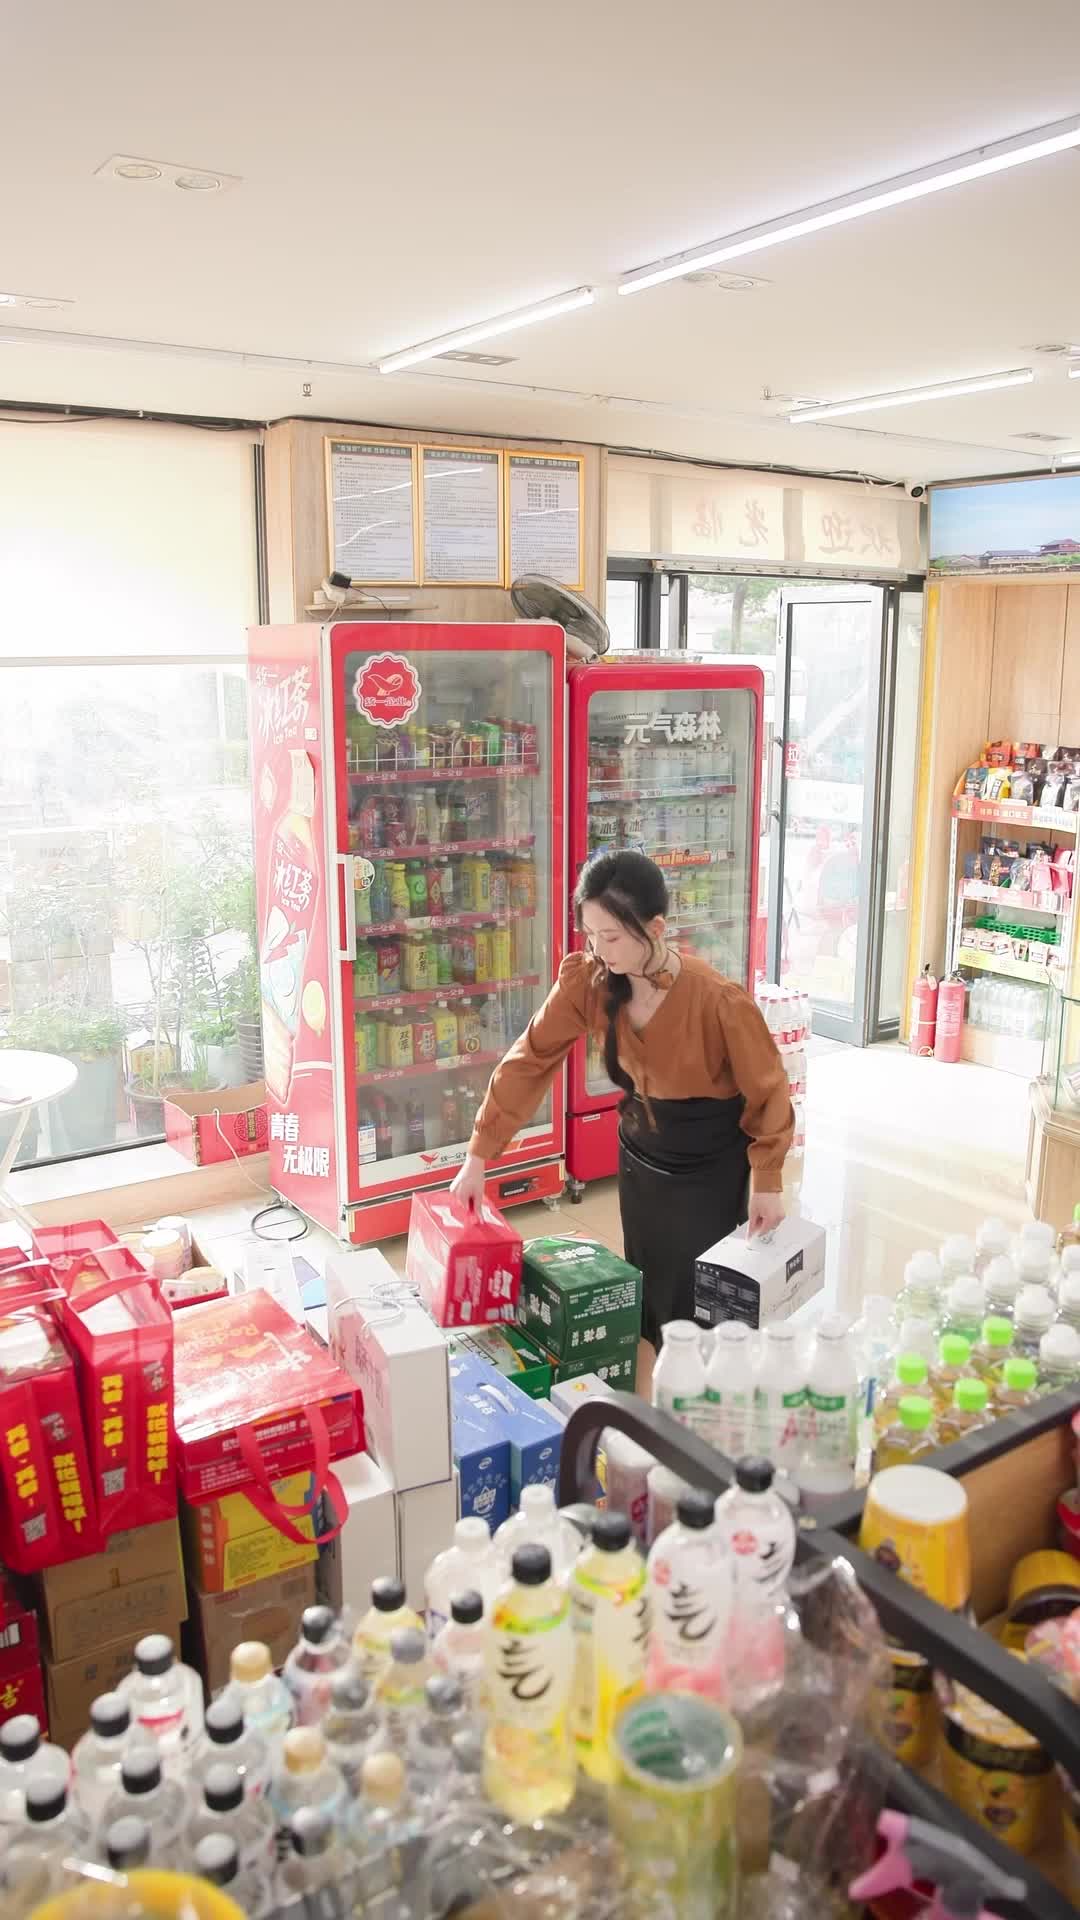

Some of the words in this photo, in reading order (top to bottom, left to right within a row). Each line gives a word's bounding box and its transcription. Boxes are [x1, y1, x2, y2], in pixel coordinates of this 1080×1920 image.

[623, 711, 722, 745] 元气森林
[270, 1112, 300, 1143] 青春
[282, 1144, 330, 1178] 无极限
